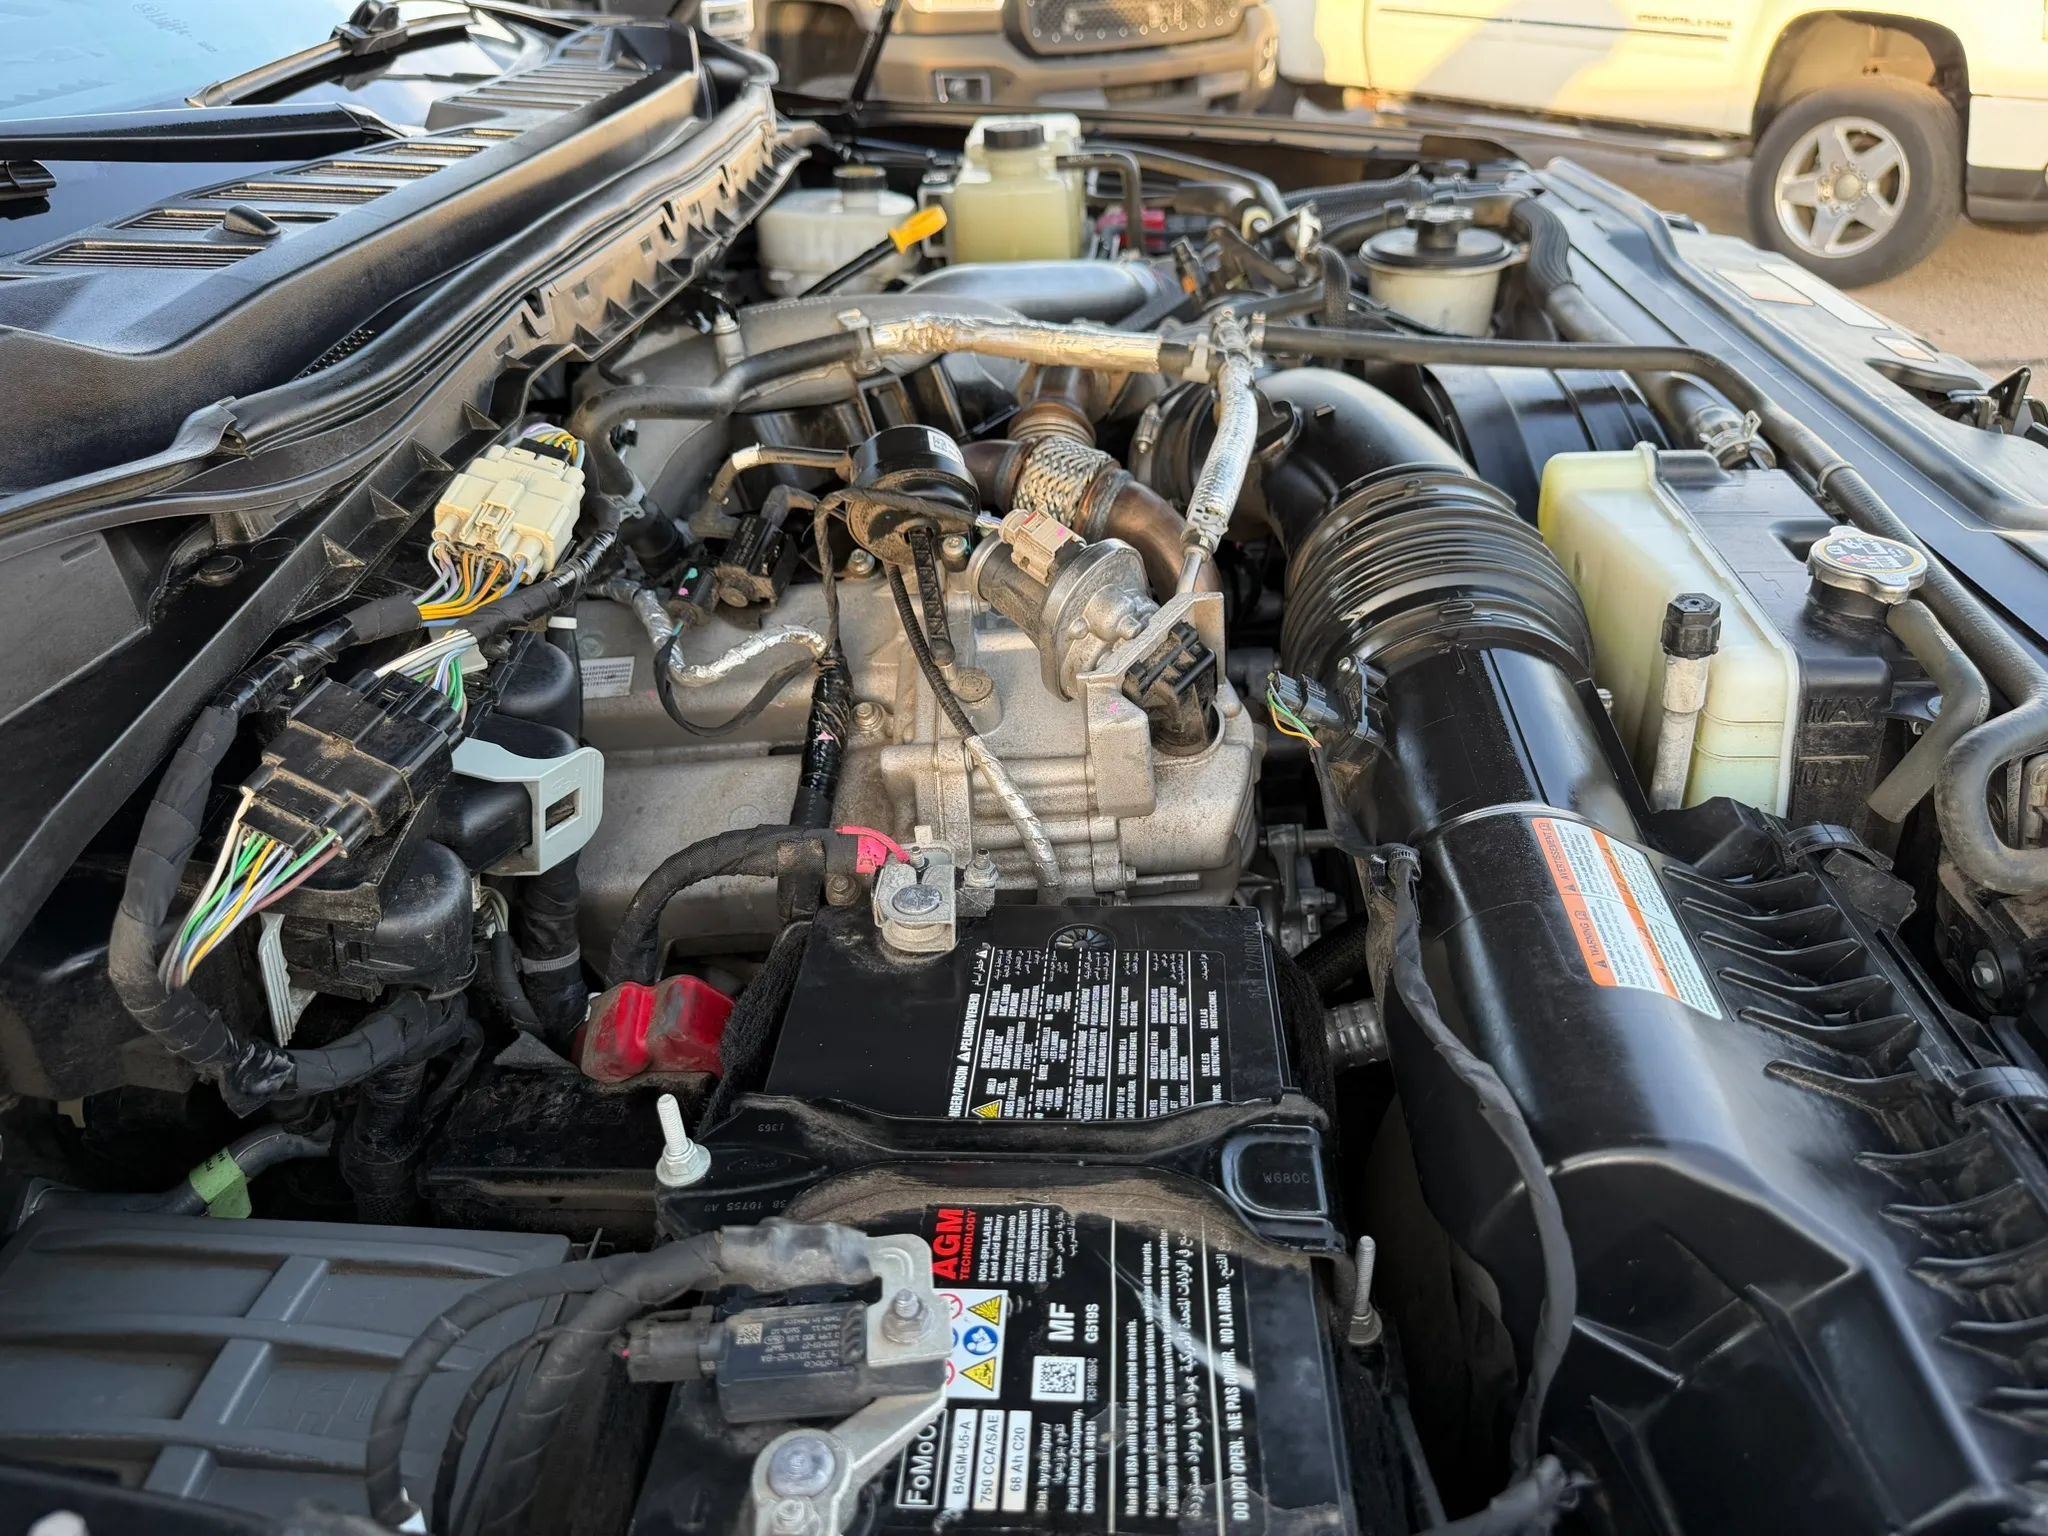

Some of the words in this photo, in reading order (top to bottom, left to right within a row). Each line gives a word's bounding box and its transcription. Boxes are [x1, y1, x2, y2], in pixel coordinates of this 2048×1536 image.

[1807, 697, 1878, 723] MAX
[1543, 832, 1570, 880] AVERTISSEMENT
[1580, 923, 1600, 956] WARNING
[1199, 1008, 1208, 1018] LAS
[1208, 989, 1218, 1029] INSTRUCCIONES.
[1200, 1019, 1209, 1029] LEA
[949, 1065, 970, 1117] NGER/POISON
[960, 993, 981, 1051] PELIGRO/VENENO
[1200, 1052, 1210, 1064] LES
[1210, 1035, 1220, 1076] INSTRUCTIONS.
[1201, 1064, 1210, 1076] LIRE
[1004, 1100, 1015, 1117] GASES
[1072, 1099, 1083, 1118] ULFURIC
[726, 1200, 762, 1212] 10755
[991, 1214, 1005, 1242] Battery
[1005, 1215, 1017, 1238] plomb
[1014, 1209, 1028, 1263] DÉVERSEMENT
[1030, 1208, 1041, 1250] DERRAMES
[932, 1208, 964, 1280] AGM
[960, 1210, 976, 1280] TECHNOLOGY
[978, 1216, 993, 1281] NON-SPILLABLE
[990, 1242, 1000, 1260] Acid
[1007, 1240, 1015, 1250] au
[1040, 1230, 1050, 1250] plomo
[1054, 1230, 1066, 1253] رصاص
[1066, 1228, 1079, 1256] للتسريب
[1142, 1240, 1154, 1276] importés.
[1176, 1249, 1194, 1257] في
[990, 1261, 1000, 1282] Lead
[1002, 1251, 1014, 1282] Batterie
[1014, 1264, 1025, 1282] ANTI
[1028, 1251, 1039, 1282] CONTRA
[1052, 1254, 1064, 1278] حمضية
[1176, 1260, 1194, 1296] الولايات
[1216, 1254, 1234, 1280] الفتح.
[1142, 1276, 1153, 1284] et
[1217, 1284, 1233, 1312] ABRA.
[1048, 1302, 1076, 1342] MF
[1084, 1304, 1100, 1344] G519S
[1176, 1298, 1192, 1329] المتحدة
[1218, 1313, 1234, 1326] LA
[1126, 1318, 1138, 1360] materials.
[1144, 1323, 1156, 1367] matériaux
[1219, 1328, 1235, 1344] NO
[804, 1359, 839, 1368] FoMoCo
[1162, 1334, 1175, 1382] materiales
[1178, 1332, 1198, 1372] الأمريكية
[1145, 1368, 1156, 1384] des
[1221, 1348, 1239, 1386] OUVRIR.
[1126, 1361, 1141, 1400] imported
[1166, 1384, 1176, 1400] con
[1181, 1376, 1198, 1406] بمواد
[1147, 1386, 1157, 1406] avec
[1224, 1386, 1241, 1411] PAS
[1126, 1401, 1138, 1418] and
[1164, 1402, 1176, 1418] UU.
[1182, 1407, 1200, 1430] منها
[1226, 1412, 1243, 1431] NE
[1012, 1426, 1026, 1451] C20
[1052, 1422, 1066, 1444] تقوم
[1070, 1408, 1084, 1456] Company,
[1085, 1420, 1097, 1448] 48121
[1126, 1419, 1138, 1433] US
[1143, 1408, 1158, 1454] États-Unis
[1165, 1420, 1177, 1436] EE.
[982, 1415, 1000, 1475] CCA/SAE
[1084, 1448, 1096, 1461] MI
[1126, 1434, 1138, 1454] with
[1165, 1436, 1177, 1450] los
[1184, 1432, 1203, 1462] ومواد
[1228, 1436, 1246, 1473] OPEN.
[906, 1417, 937, 1504] FoMoC
[954, 1420, 972, 1494] BAGM-65-A
[1010, 1455, 1023, 1472] Ah
[1126, 1455, 1138, 1475] USA
[1148, 1454, 1158, 1471] aux
[1168, 1452, 1178, 1463] en
[1009, 1476, 1022, 1492] 68
[1068, 1458, 1080, 1485] Motor
[1126, 1476, 1138, 1486] in
[980, 1480, 993, 1503] 750
[1036, 1487, 1048, 1512] Dist.
[1068, 1487, 1080, 1512] Ford
[1083, 1462, 1097, 1512] Dearborn,
[1145, 1474, 1160, 1516] Fabriqué
[1186, 1466, 1206, 1517] مستوردة
[1230, 1474, 1248, 1500] NOT
[1126, 1488, 1139, 1516] Made
[1232, 1502, 1250, 1520] DO
